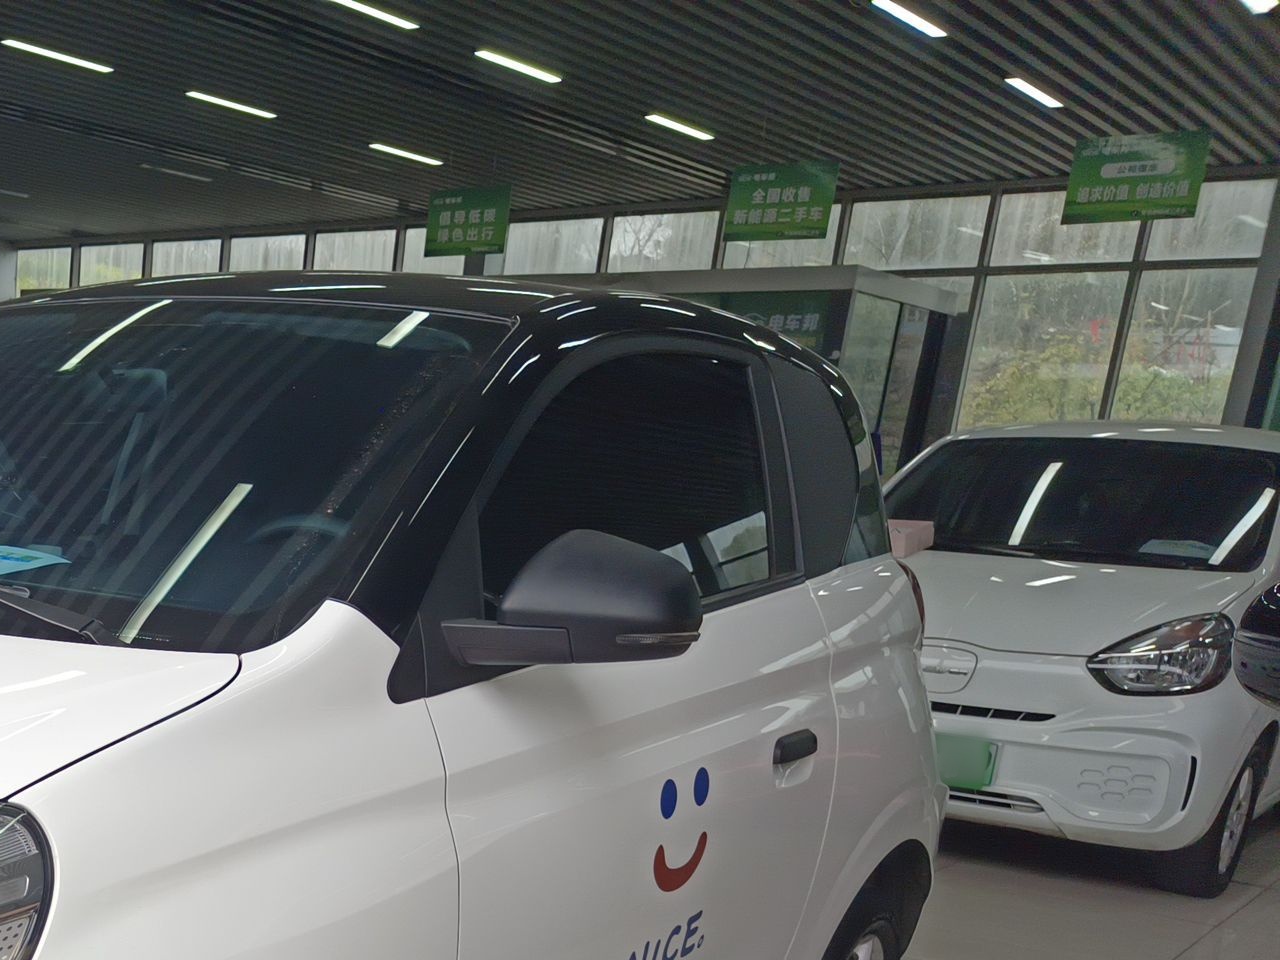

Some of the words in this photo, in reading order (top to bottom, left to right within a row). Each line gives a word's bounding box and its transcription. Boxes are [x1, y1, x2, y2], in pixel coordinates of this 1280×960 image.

[751, 186, 812, 204] 全国收售
[1076, 184, 1130, 203] 追求价值
[733, 207, 824, 225] 新能源二手车
[769, 312, 820, 332] 电车邦
